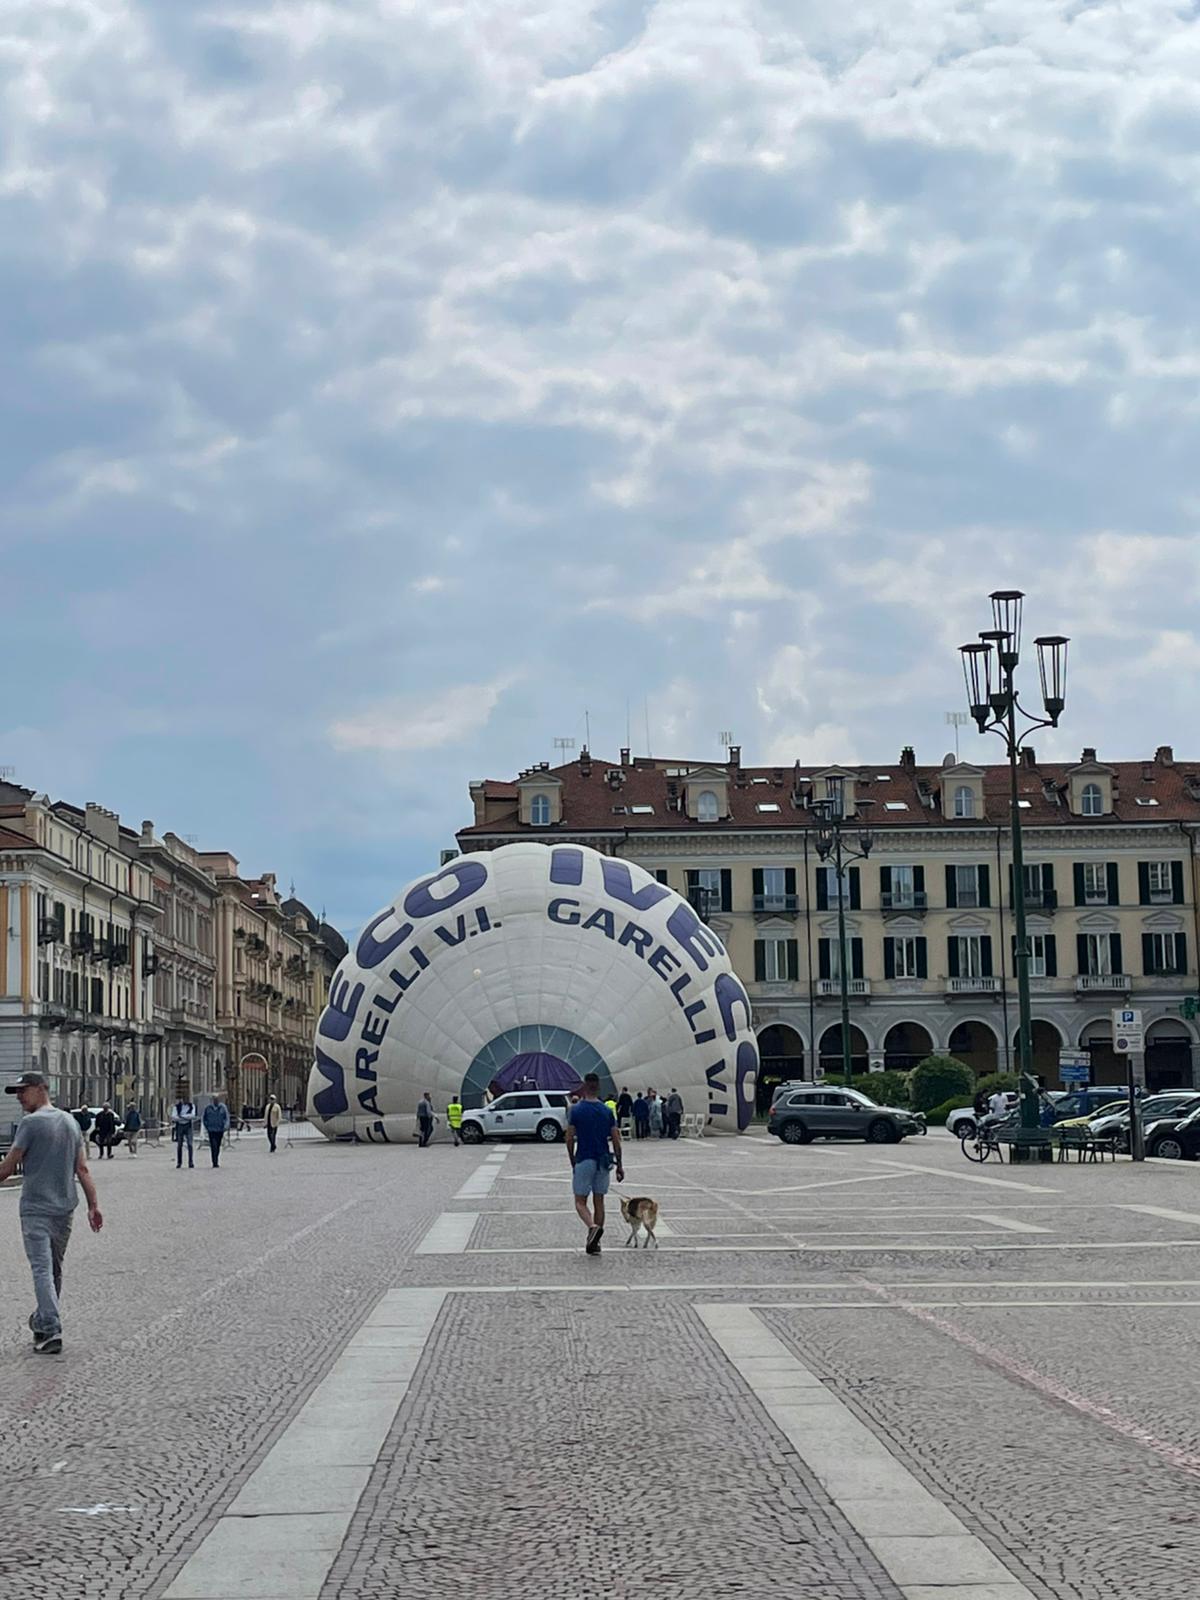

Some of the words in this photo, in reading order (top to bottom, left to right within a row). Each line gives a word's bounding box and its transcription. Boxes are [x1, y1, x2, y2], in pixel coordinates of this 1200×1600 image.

[434, 906, 502, 947] V.I.
[547, 898, 717, 1046] GARELLI
[705, 1058, 728, 1125] V.I.
[549, 848, 758, 1132] IVECO
